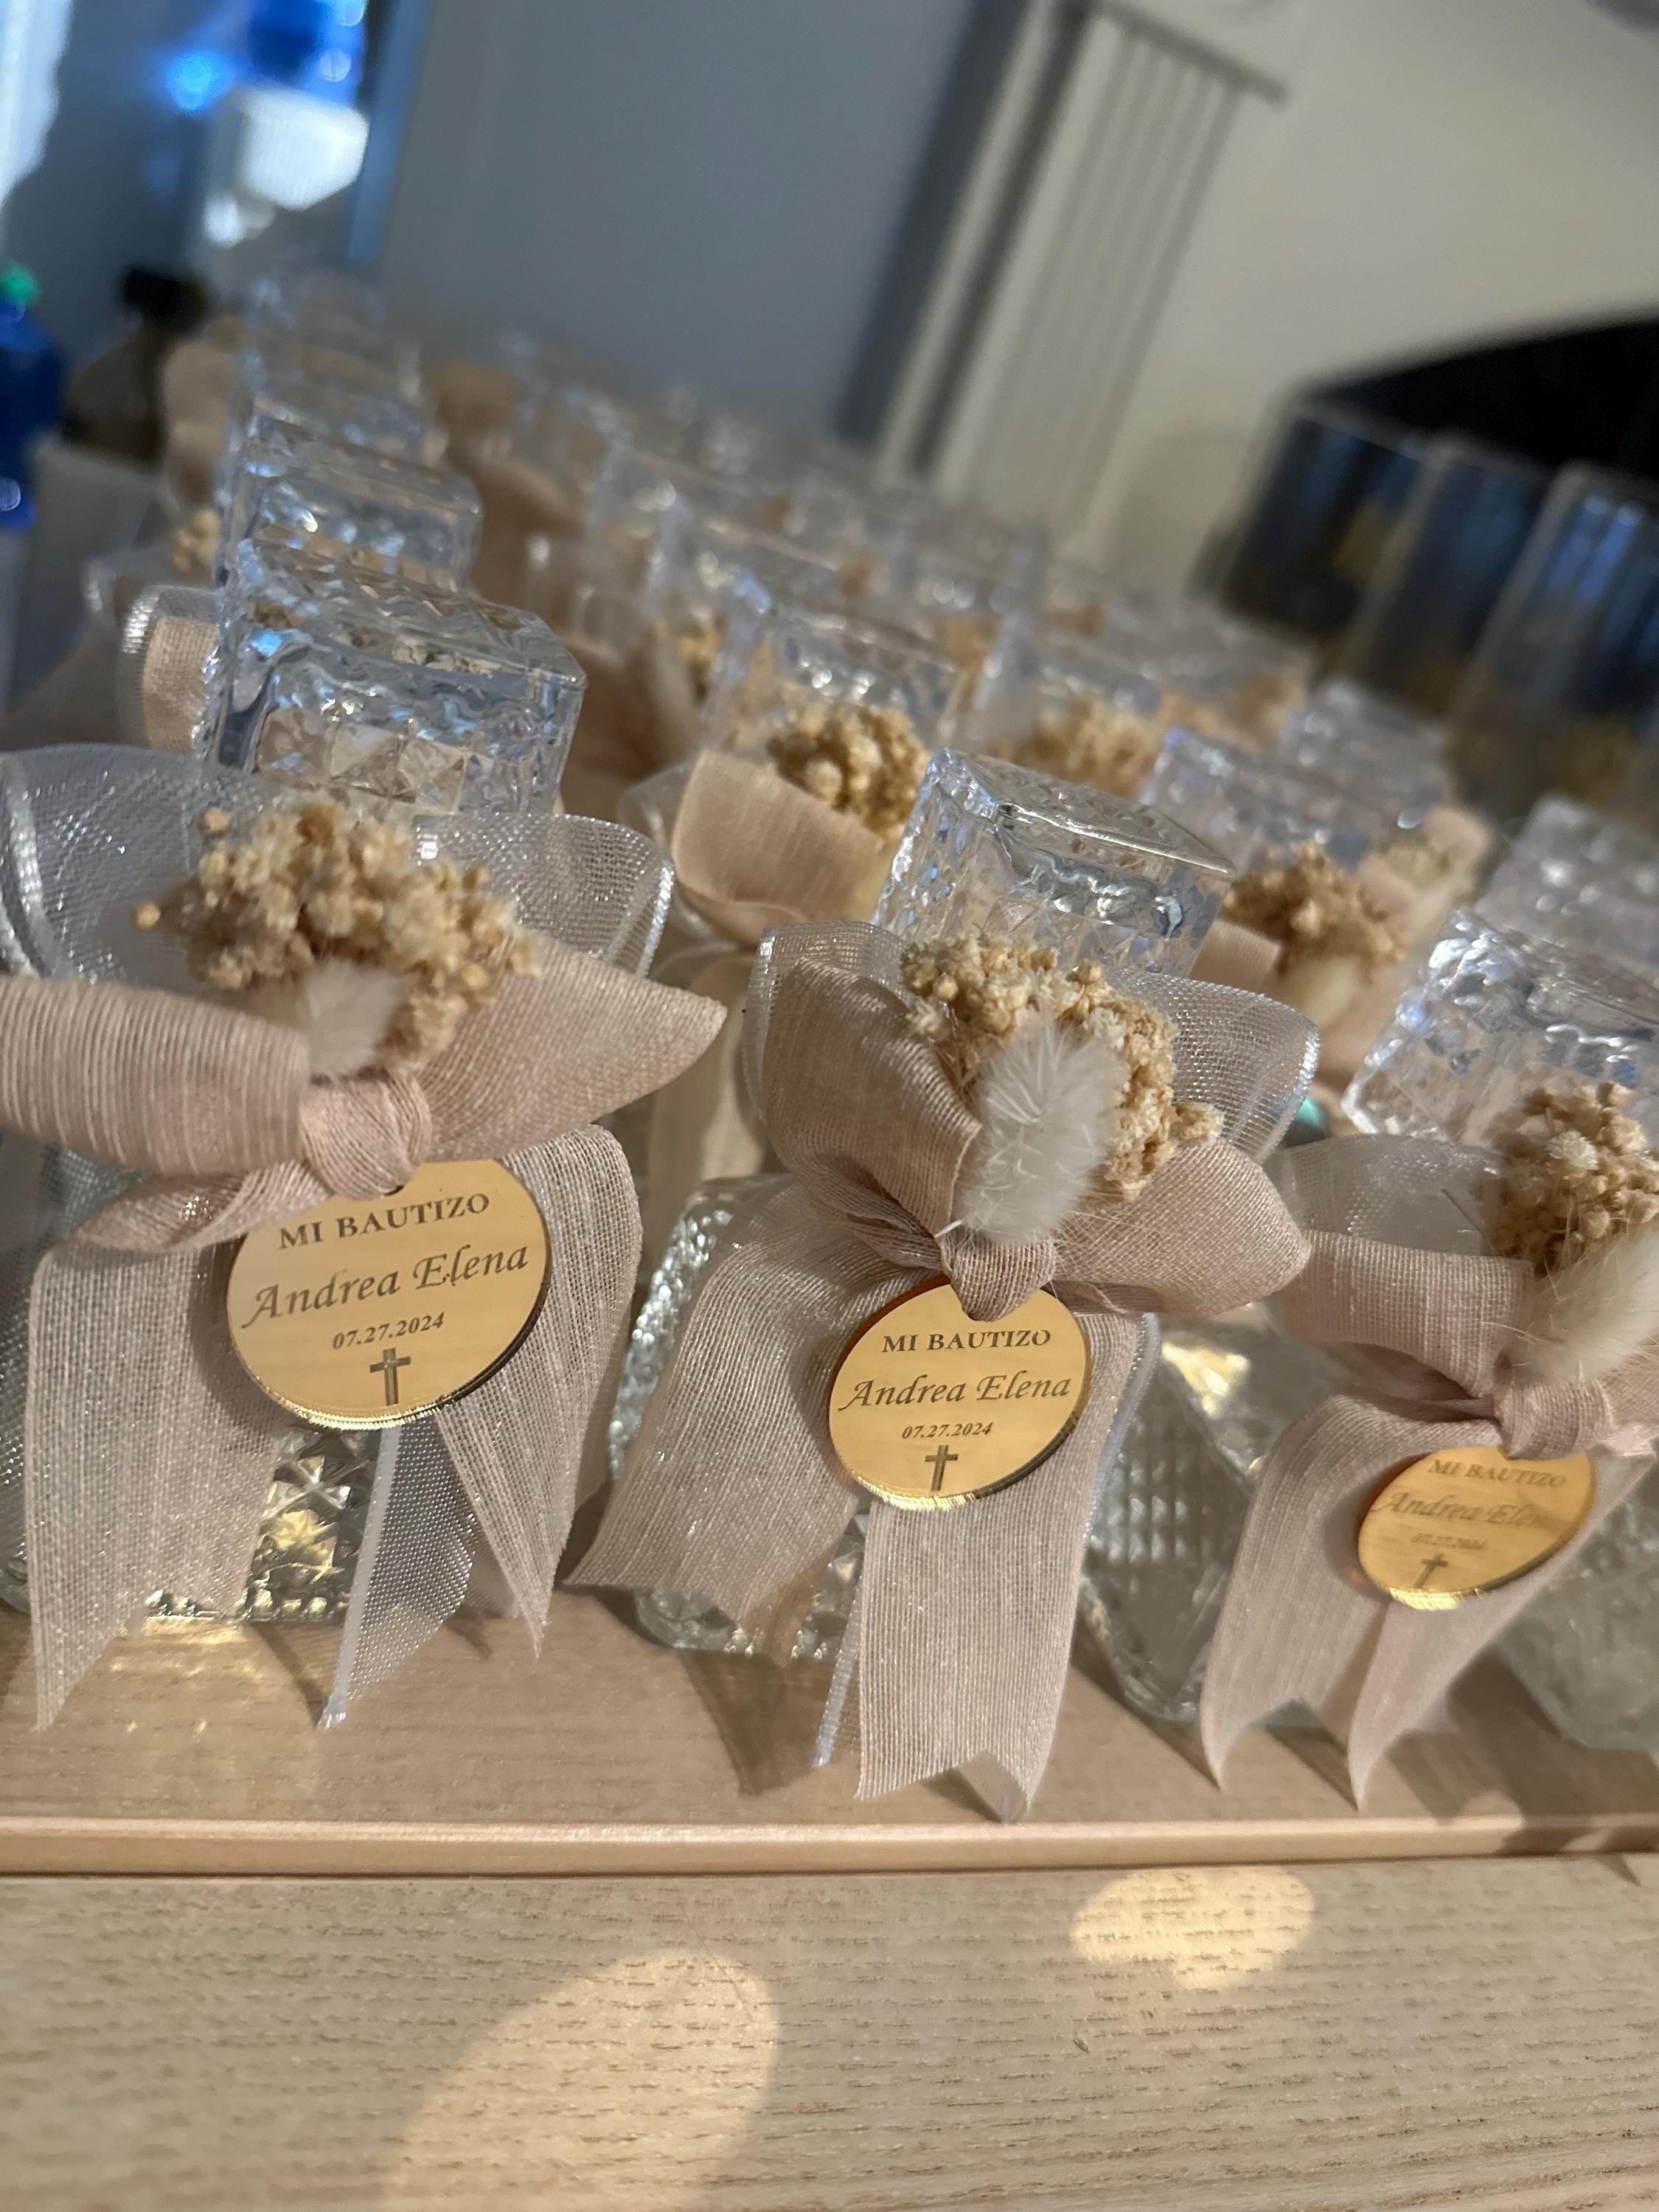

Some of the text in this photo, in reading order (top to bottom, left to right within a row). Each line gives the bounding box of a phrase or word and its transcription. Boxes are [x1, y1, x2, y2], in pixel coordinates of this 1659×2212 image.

[279, 1193, 490, 1249] MI BAUTIZO
[241, 1244, 529, 1329] Andrea Elena
[333, 1312, 445, 1349] 07.27.2024
[881, 1329, 1051, 1352] MI BAUTIZO
[838, 1370, 1072, 1411] Andrea Elena
[901, 1422, 995, 1439] 07.27.2024
[1427, 1459, 1567, 1487] MI BAUTIZO
[1370, 1492, 1482, 1521] Andrea
